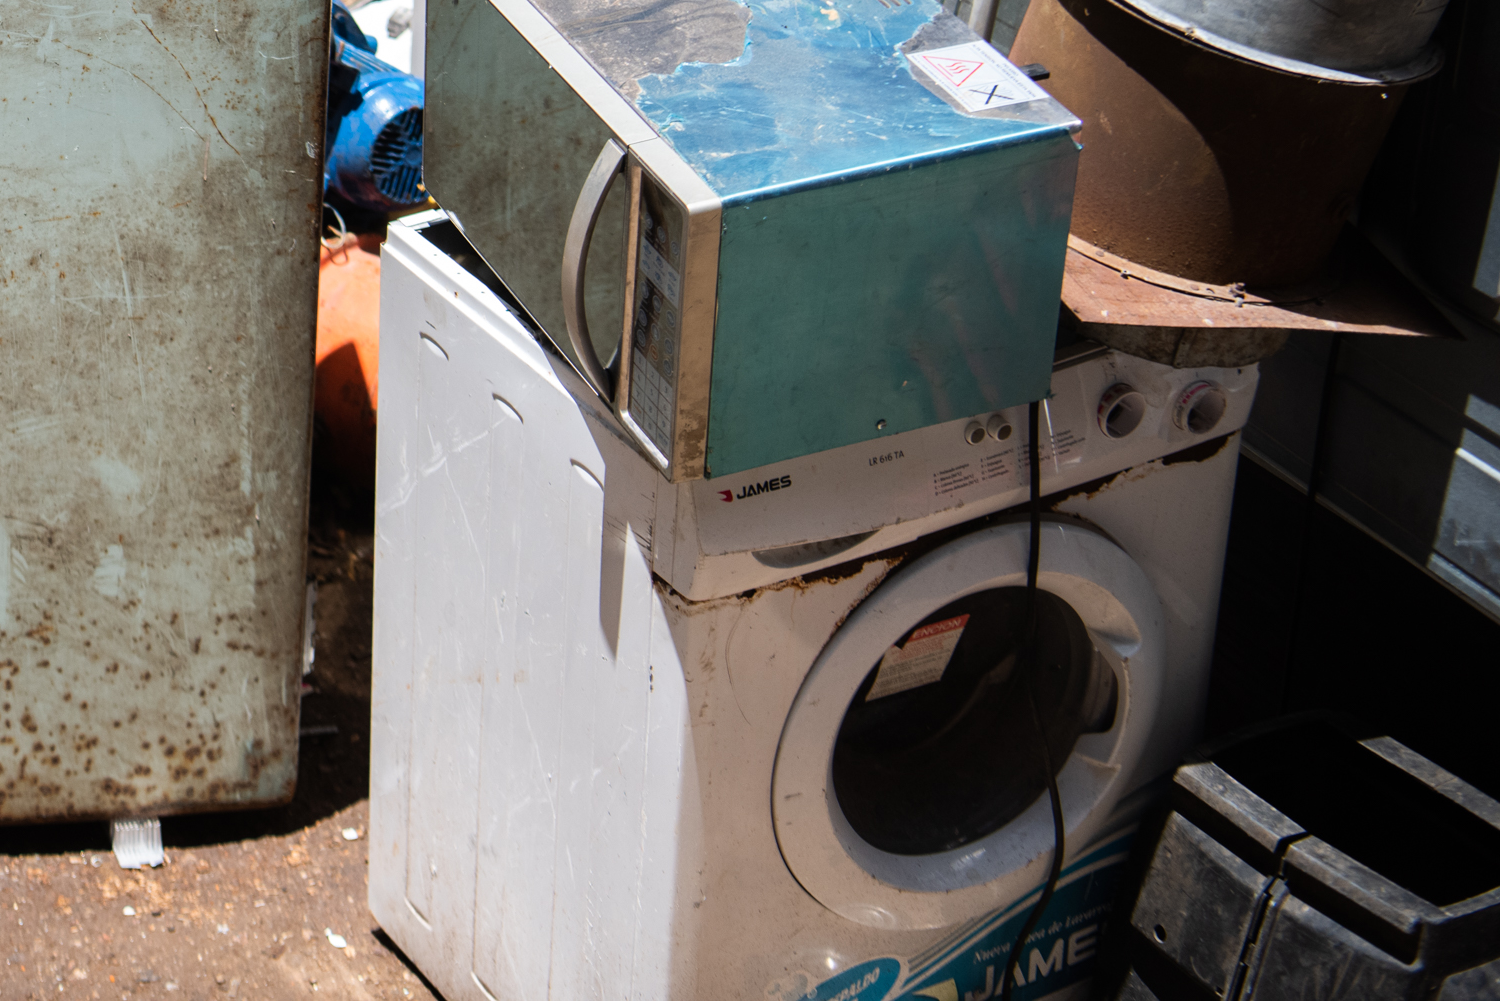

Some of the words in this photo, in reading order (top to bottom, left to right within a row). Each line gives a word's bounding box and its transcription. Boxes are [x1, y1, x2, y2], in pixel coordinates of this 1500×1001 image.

[868, 456, 879, 466] LR
[879, 452, 893, 464] 616
[893, 449, 905, 460] TA
[736, 474, 792, 500] JAMES
[912, 617, 962, 639] ENCION
[964, 922, 1108, 1001] JAME
